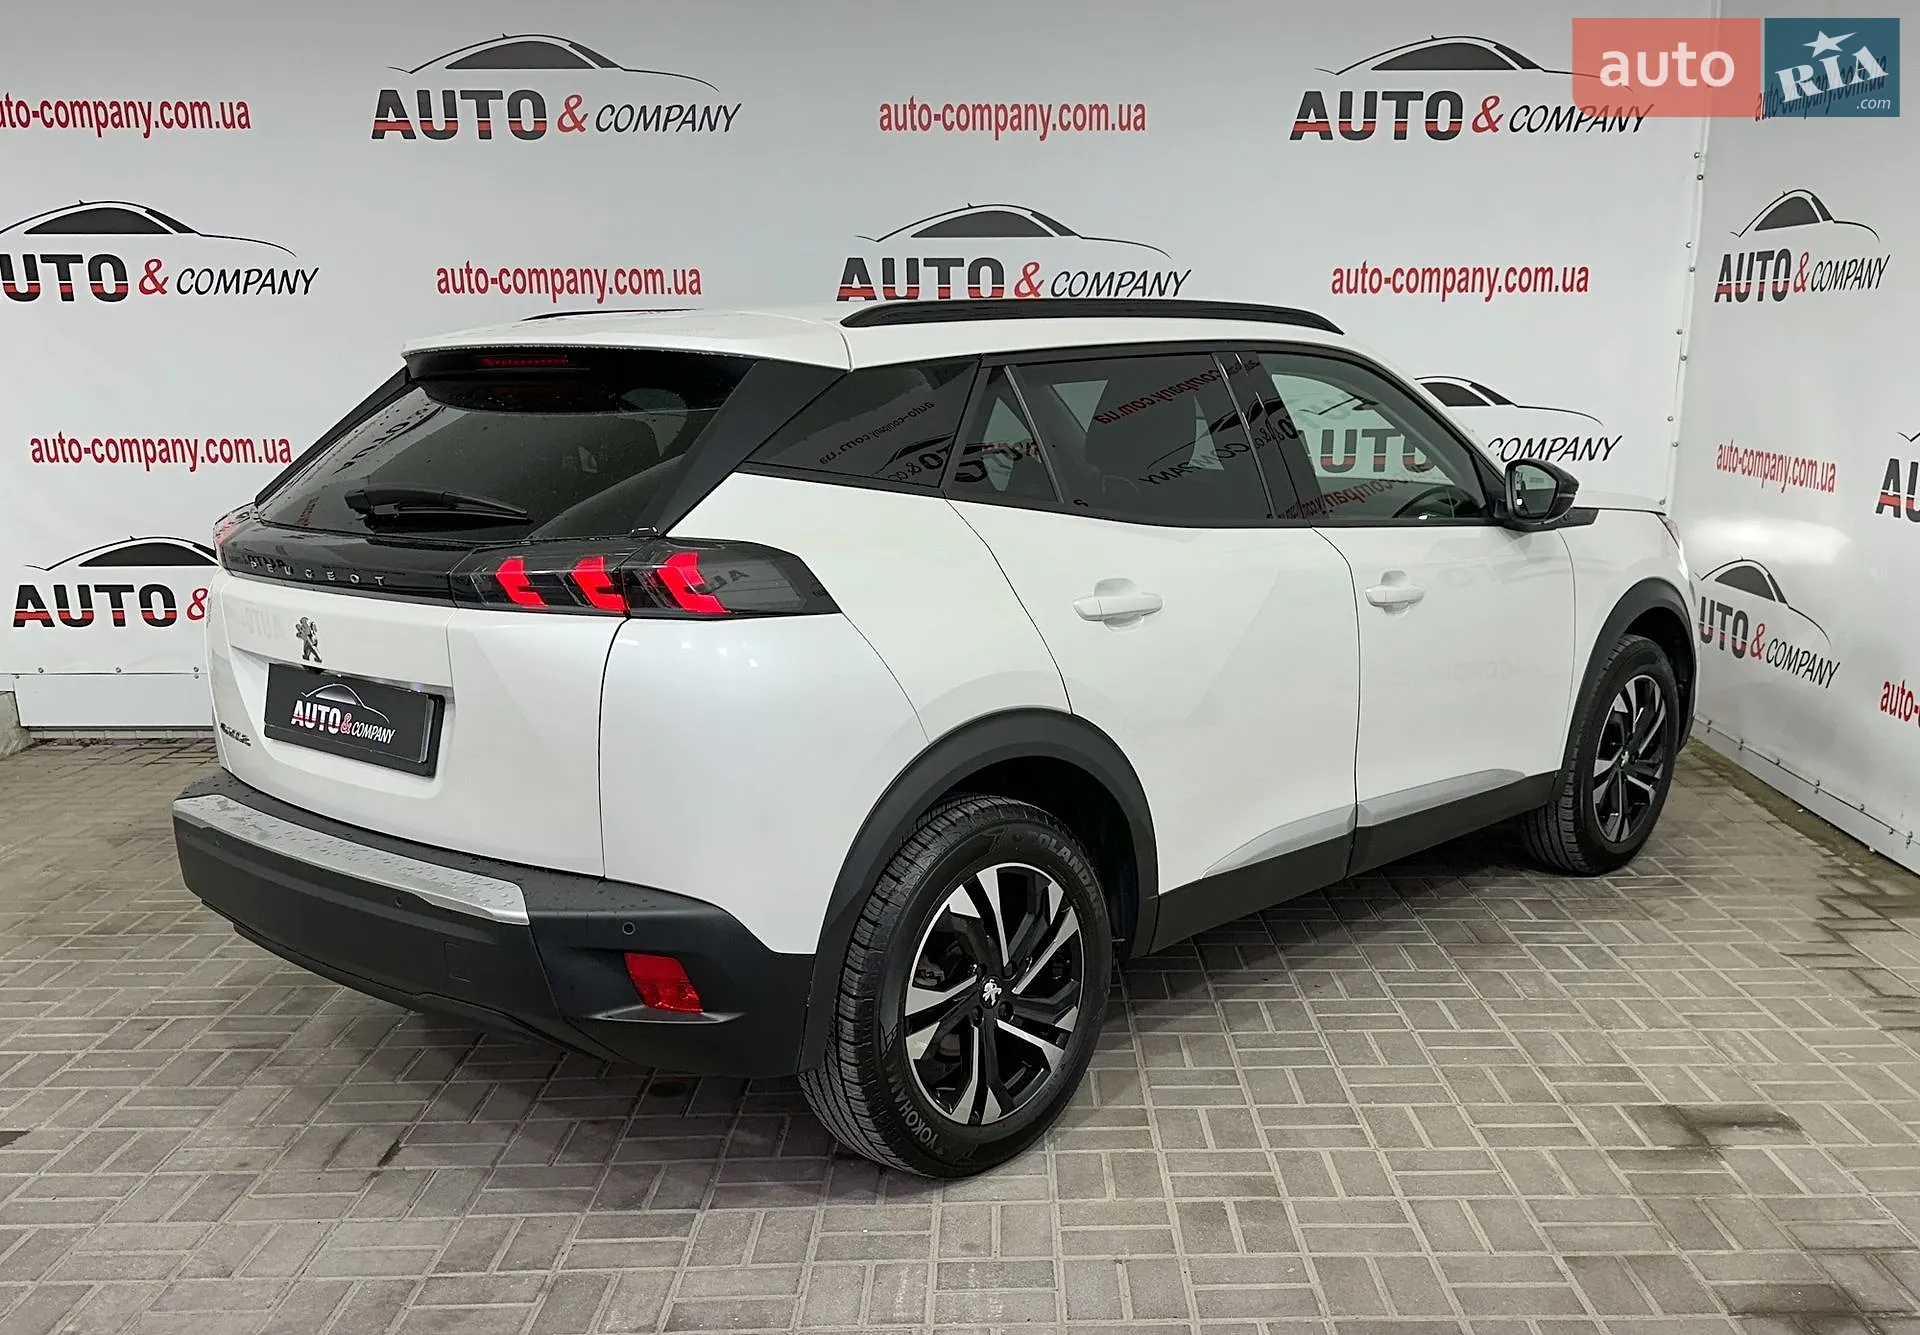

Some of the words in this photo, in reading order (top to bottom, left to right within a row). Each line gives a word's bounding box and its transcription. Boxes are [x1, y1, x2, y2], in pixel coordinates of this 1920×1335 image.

[371, 89, 547, 141] AUTO
[557, 94, 589, 134] &
[594, 103, 742, 133] COMPANY
[879, 96, 1146, 141] auto-company.com.ua
[1289, 90, 1464, 141] AUTO
[1472, 95, 1504, 134] &
[1508, 103, 1653, 133] COMPANY
[138, 258, 169, 296] &
[176, 267, 319, 296] COMPANY
[436, 260, 702, 304] auto-company.com.ua
[836, 256, 1005, 299] AUTO
[1014, 261, 1045, 298] &
[1050, 269, 1192, 298] COMPANY
[1331, 259, 1589, 302] auto-company.com.ua
[1714, 249, 1791, 303] AUTO
[1793, 251, 1811, 293] &
[1811, 254, 1890, 292] COMPANY
[30, 431, 292, 472] auto-company.com.ua
[1716, 440, 1837, 493] auto-company.com.ua
[250, 560, 386, 586] PEUGEOT
[13, 583, 178, 628] AUTO
[186, 587, 209, 621] &
[1750, 623, 1766, 661] &
[1766, 638, 1841, 688] COMPANY
[291, 699, 341, 735] AUTO
[340, 712, 353, 735] &
[352, 725, 396, 744] COMPANY
